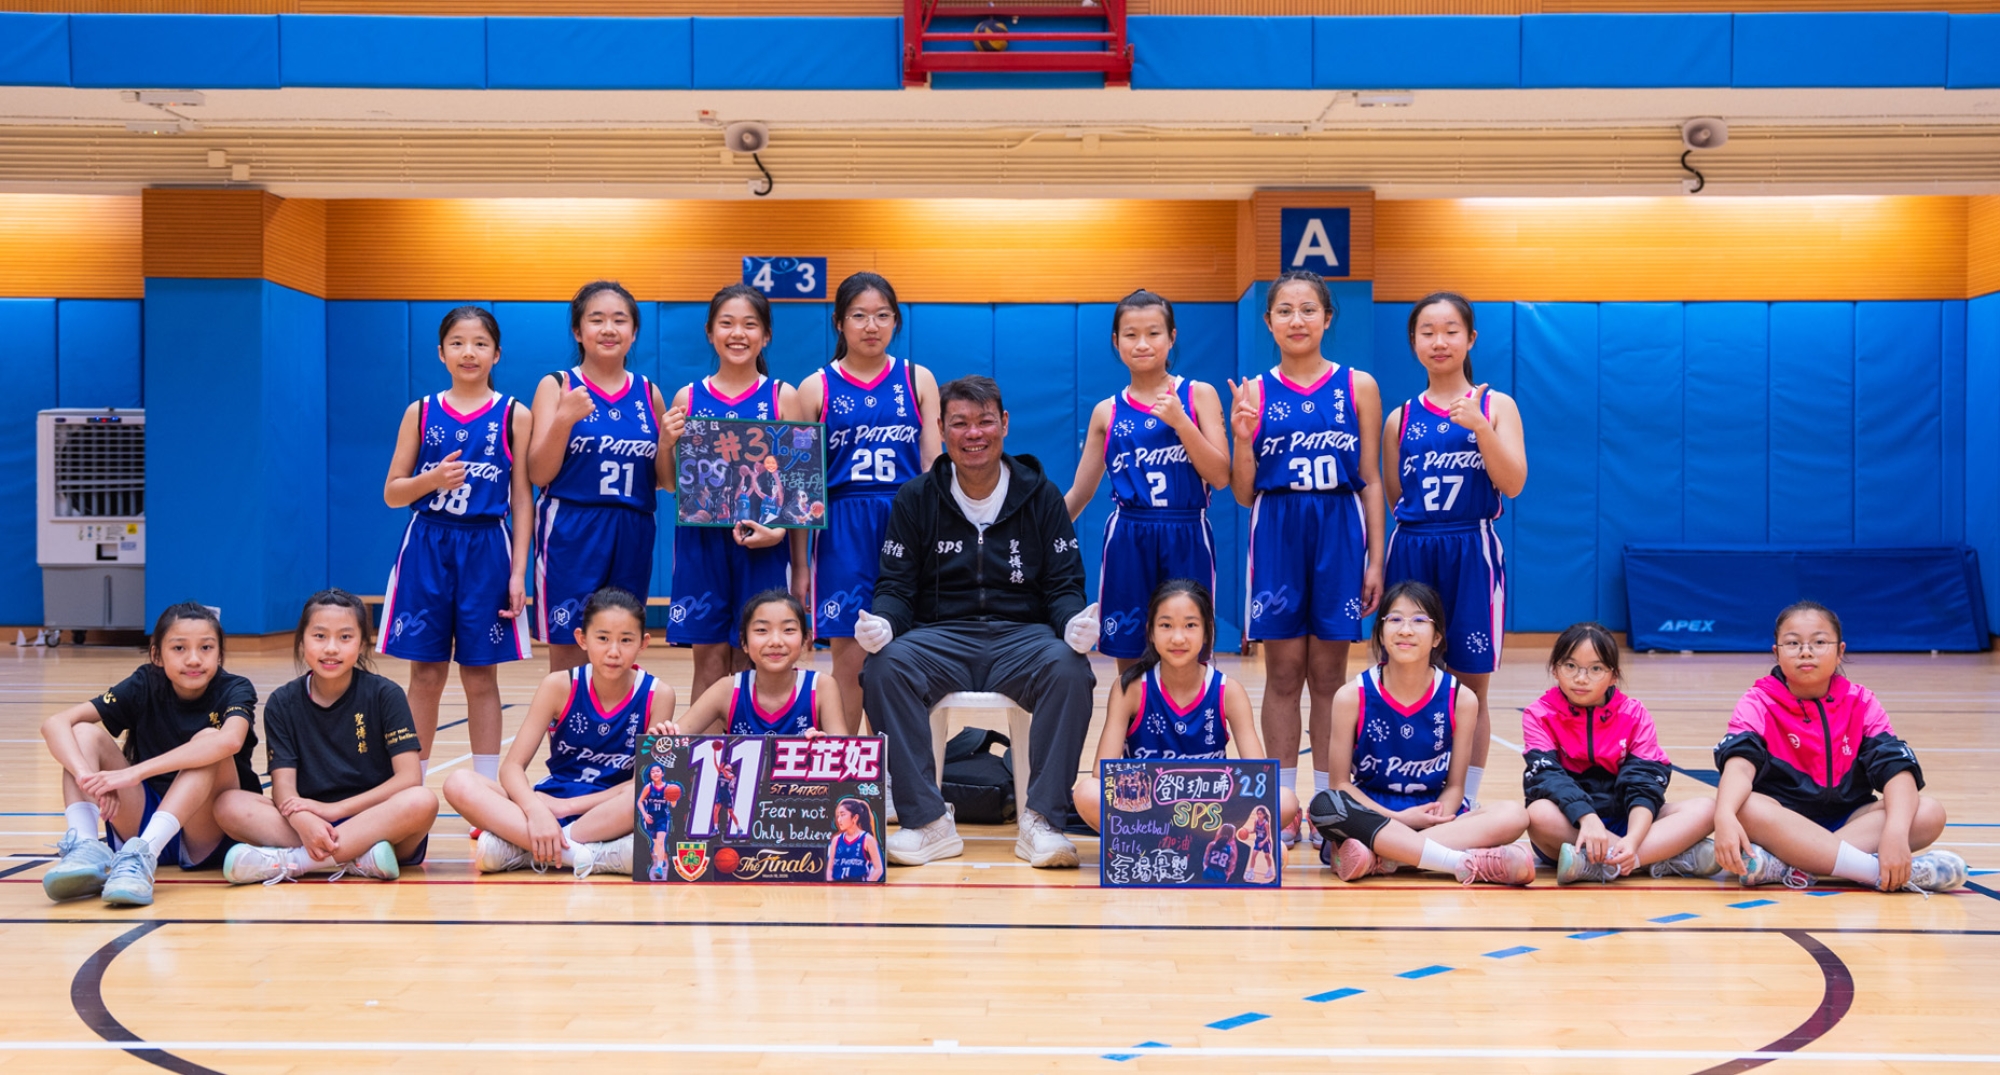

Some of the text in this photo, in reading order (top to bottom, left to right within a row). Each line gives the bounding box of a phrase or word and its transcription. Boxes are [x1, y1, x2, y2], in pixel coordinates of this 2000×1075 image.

[1291, 218, 1339, 267] A
[753, 263, 816, 292] 4 3
[570, 436, 595, 454] ST.
[713, 426, 769, 463] #3
[829, 424, 919, 450] ST. PATRICK
[1260, 430, 1359, 457] ST. PATRICK
[599, 460, 635, 498] 21
[678, 457, 730, 488] SPS
[850, 448, 897, 482] 26
[1288, 454, 1339, 491] 30
[428, 483, 472, 516] 38
[1146, 471, 1169, 507] 2
[1422, 475, 1464, 511] 27
[936, 540, 964, 554] SPS
[1008, 538, 1025, 584] 聖博德
[1658, 620, 1716, 632] APEX
[772, 739, 881, 780] 王芷妃
[689, 738, 764, 837] 11
[788, 784, 829, 795] PATRICK
[1239, 772, 1267, 799] 28
[759, 801, 829, 818] Fear not.
[1173, 801, 1223, 831] SPS
[752, 820, 832, 843] Only believe
[1110, 815, 1171, 836] Basketball
[1111, 837, 1142, 854] Girls
[1209, 850, 1229, 867] 28
[737, 849, 820, 876] The Finals
